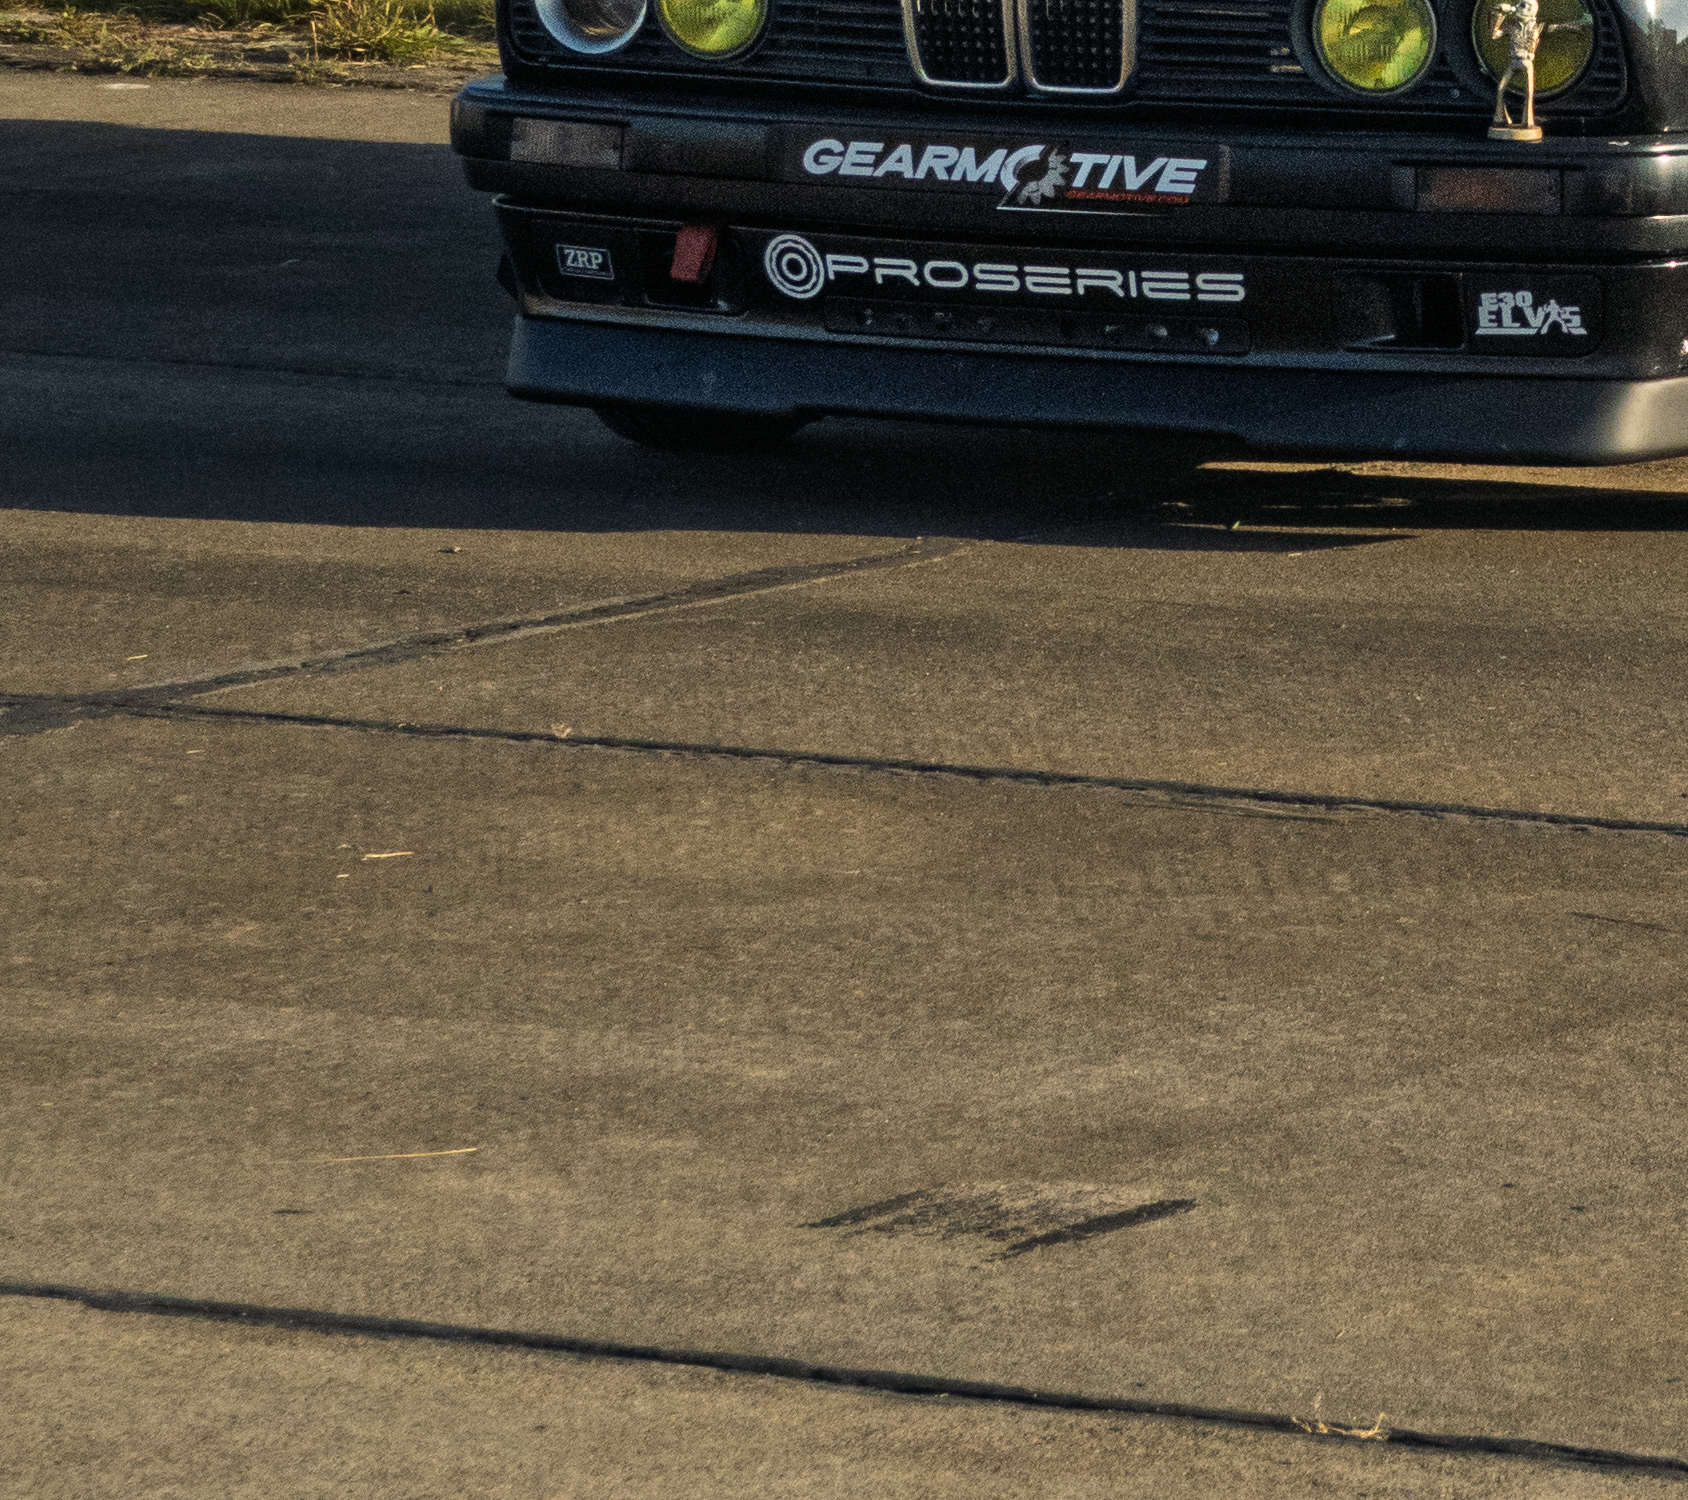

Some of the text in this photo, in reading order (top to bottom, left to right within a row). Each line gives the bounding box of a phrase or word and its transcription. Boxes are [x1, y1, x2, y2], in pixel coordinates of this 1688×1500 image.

[802, 137, 1207, 197] GEARMOTIVE
[563, 248, 604, 270] ZRP
[825, 253, 1247, 302] PROSERIES
[1480, 290, 1534, 308] E30
